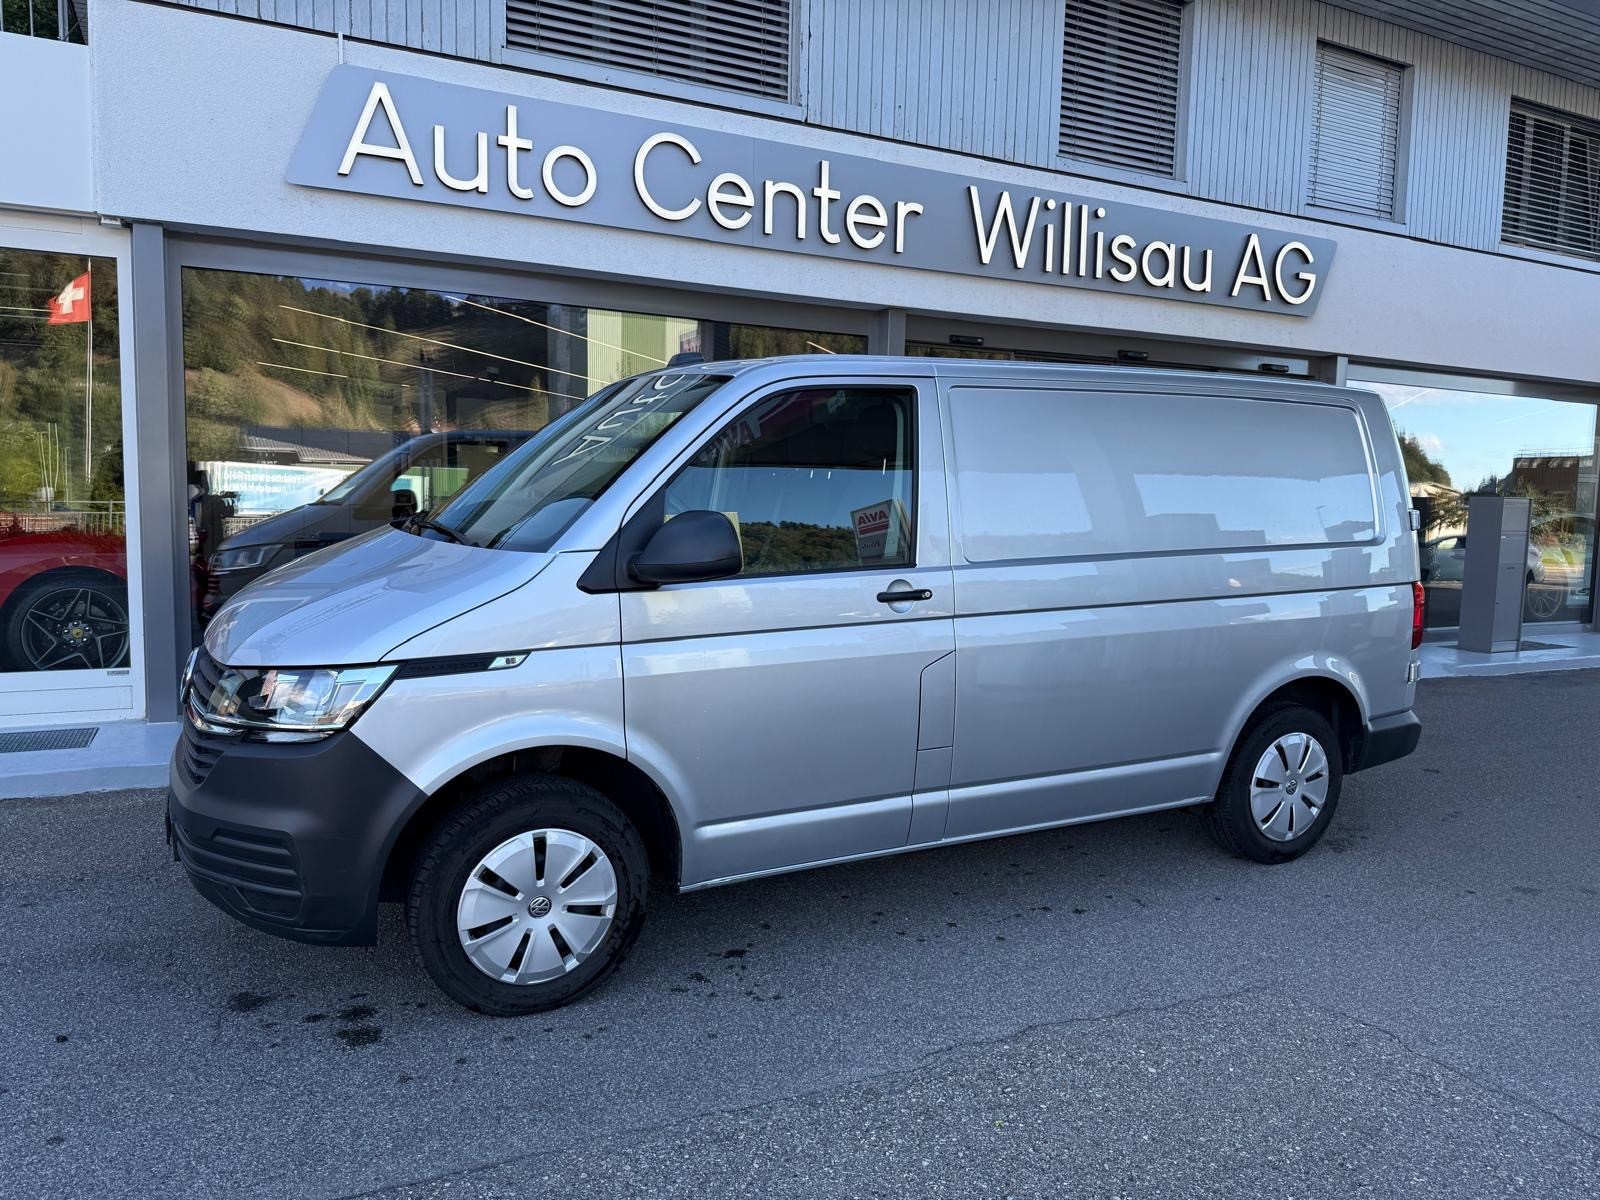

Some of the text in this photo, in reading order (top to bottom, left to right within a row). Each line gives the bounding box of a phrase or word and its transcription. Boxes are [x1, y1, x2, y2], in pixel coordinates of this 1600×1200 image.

[338, 81, 1317, 306] Auto Center Willisau AG
